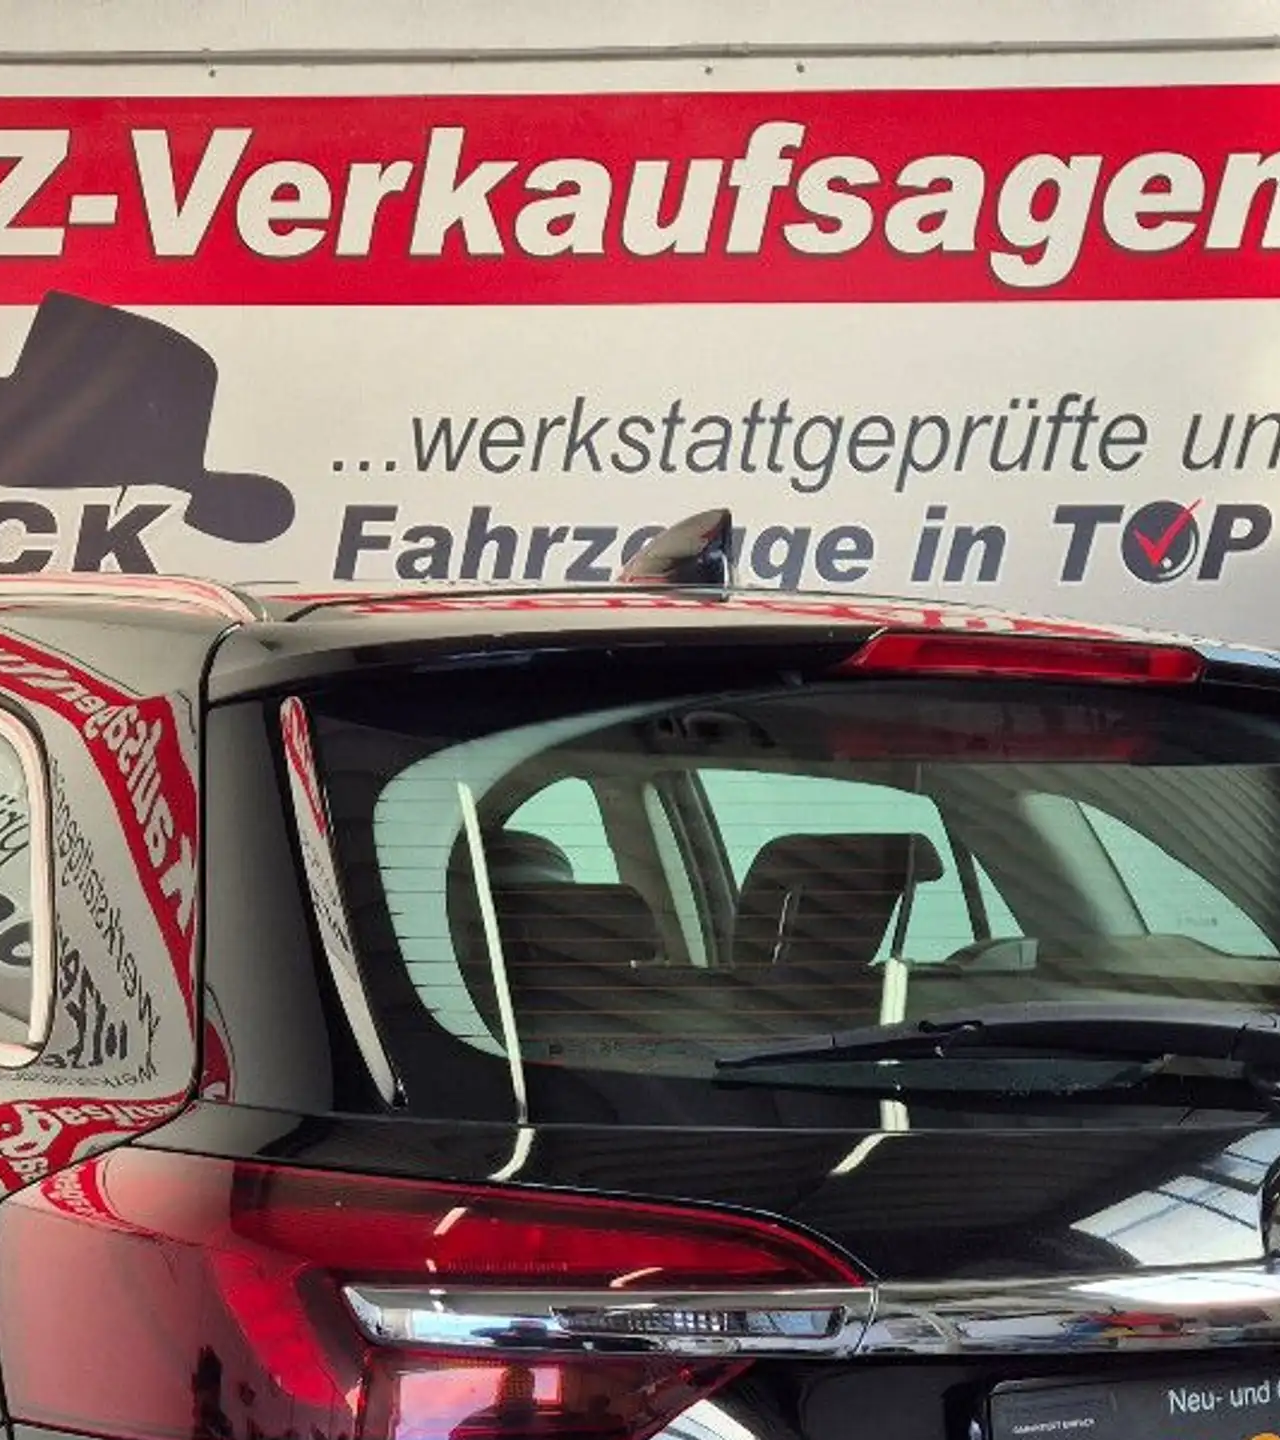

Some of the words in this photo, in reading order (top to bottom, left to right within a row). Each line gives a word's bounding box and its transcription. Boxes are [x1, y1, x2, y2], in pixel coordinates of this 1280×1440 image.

[332, 503, 875, 592] Fahrzge
[910, 505, 1007, 584] in
[1054, 498, 1273, 584] TOP
[1168, 1388, 1224, 1415] Neu-
[1229, 1380, 1270, 1408] und
